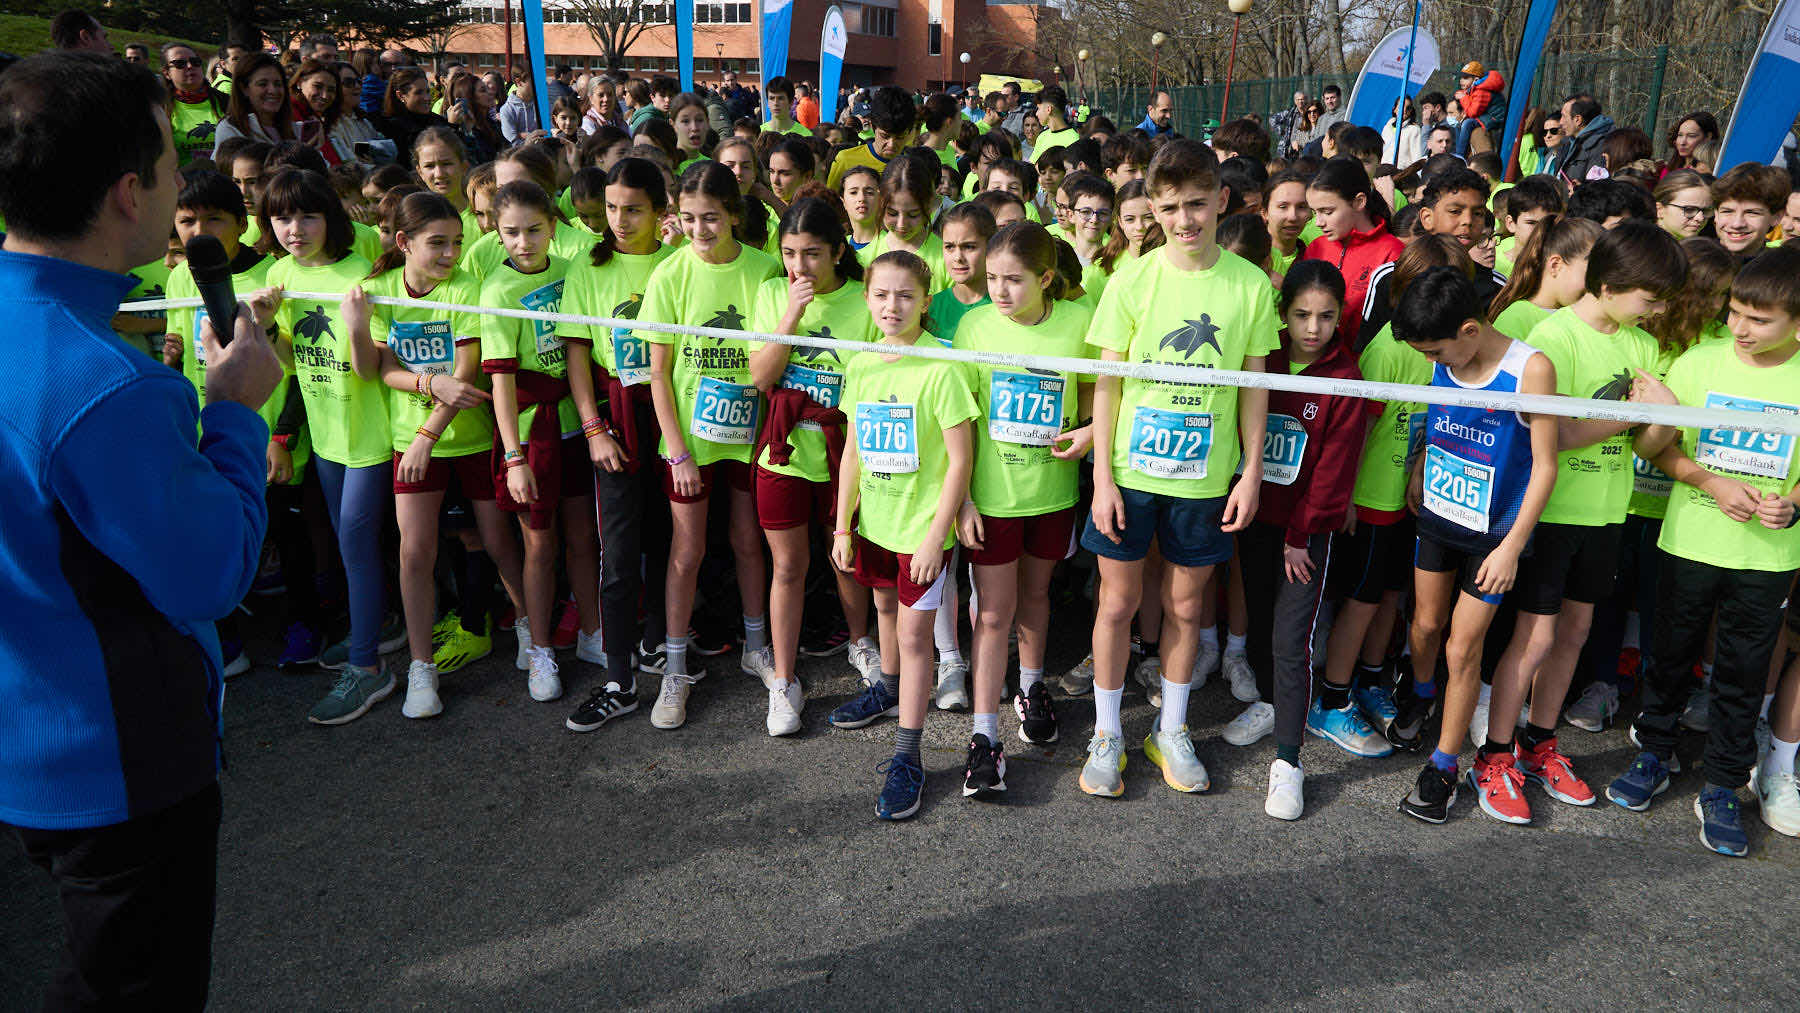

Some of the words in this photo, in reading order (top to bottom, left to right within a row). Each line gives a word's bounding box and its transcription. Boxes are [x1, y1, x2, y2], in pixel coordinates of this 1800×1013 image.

[683, 347, 745, 358] CARRERA
[695, 358, 749, 369] VALIENT
[817, 374, 839, 385] 1500M
[1039, 380, 1062, 392] 1500M
[997, 389, 1055, 424] 2175
[1172, 395, 1202, 406] 2025
[702, 395, 753, 425] 2063
[889, 408, 911, 418] 1500M
[1184, 416, 1209, 428] 1500M
[862, 421, 908, 451] 2176
[1434, 415, 1495, 447] adentro
[1138, 424, 1202, 459] 2072
[1263, 432, 1297, 463] 201
[1601, 446, 1622, 455] 2025
[1720, 450, 1775, 470] CaixaBank
[1149, 461, 1200, 474] CaixaBank
[1430, 466, 1480, 509] 2205
